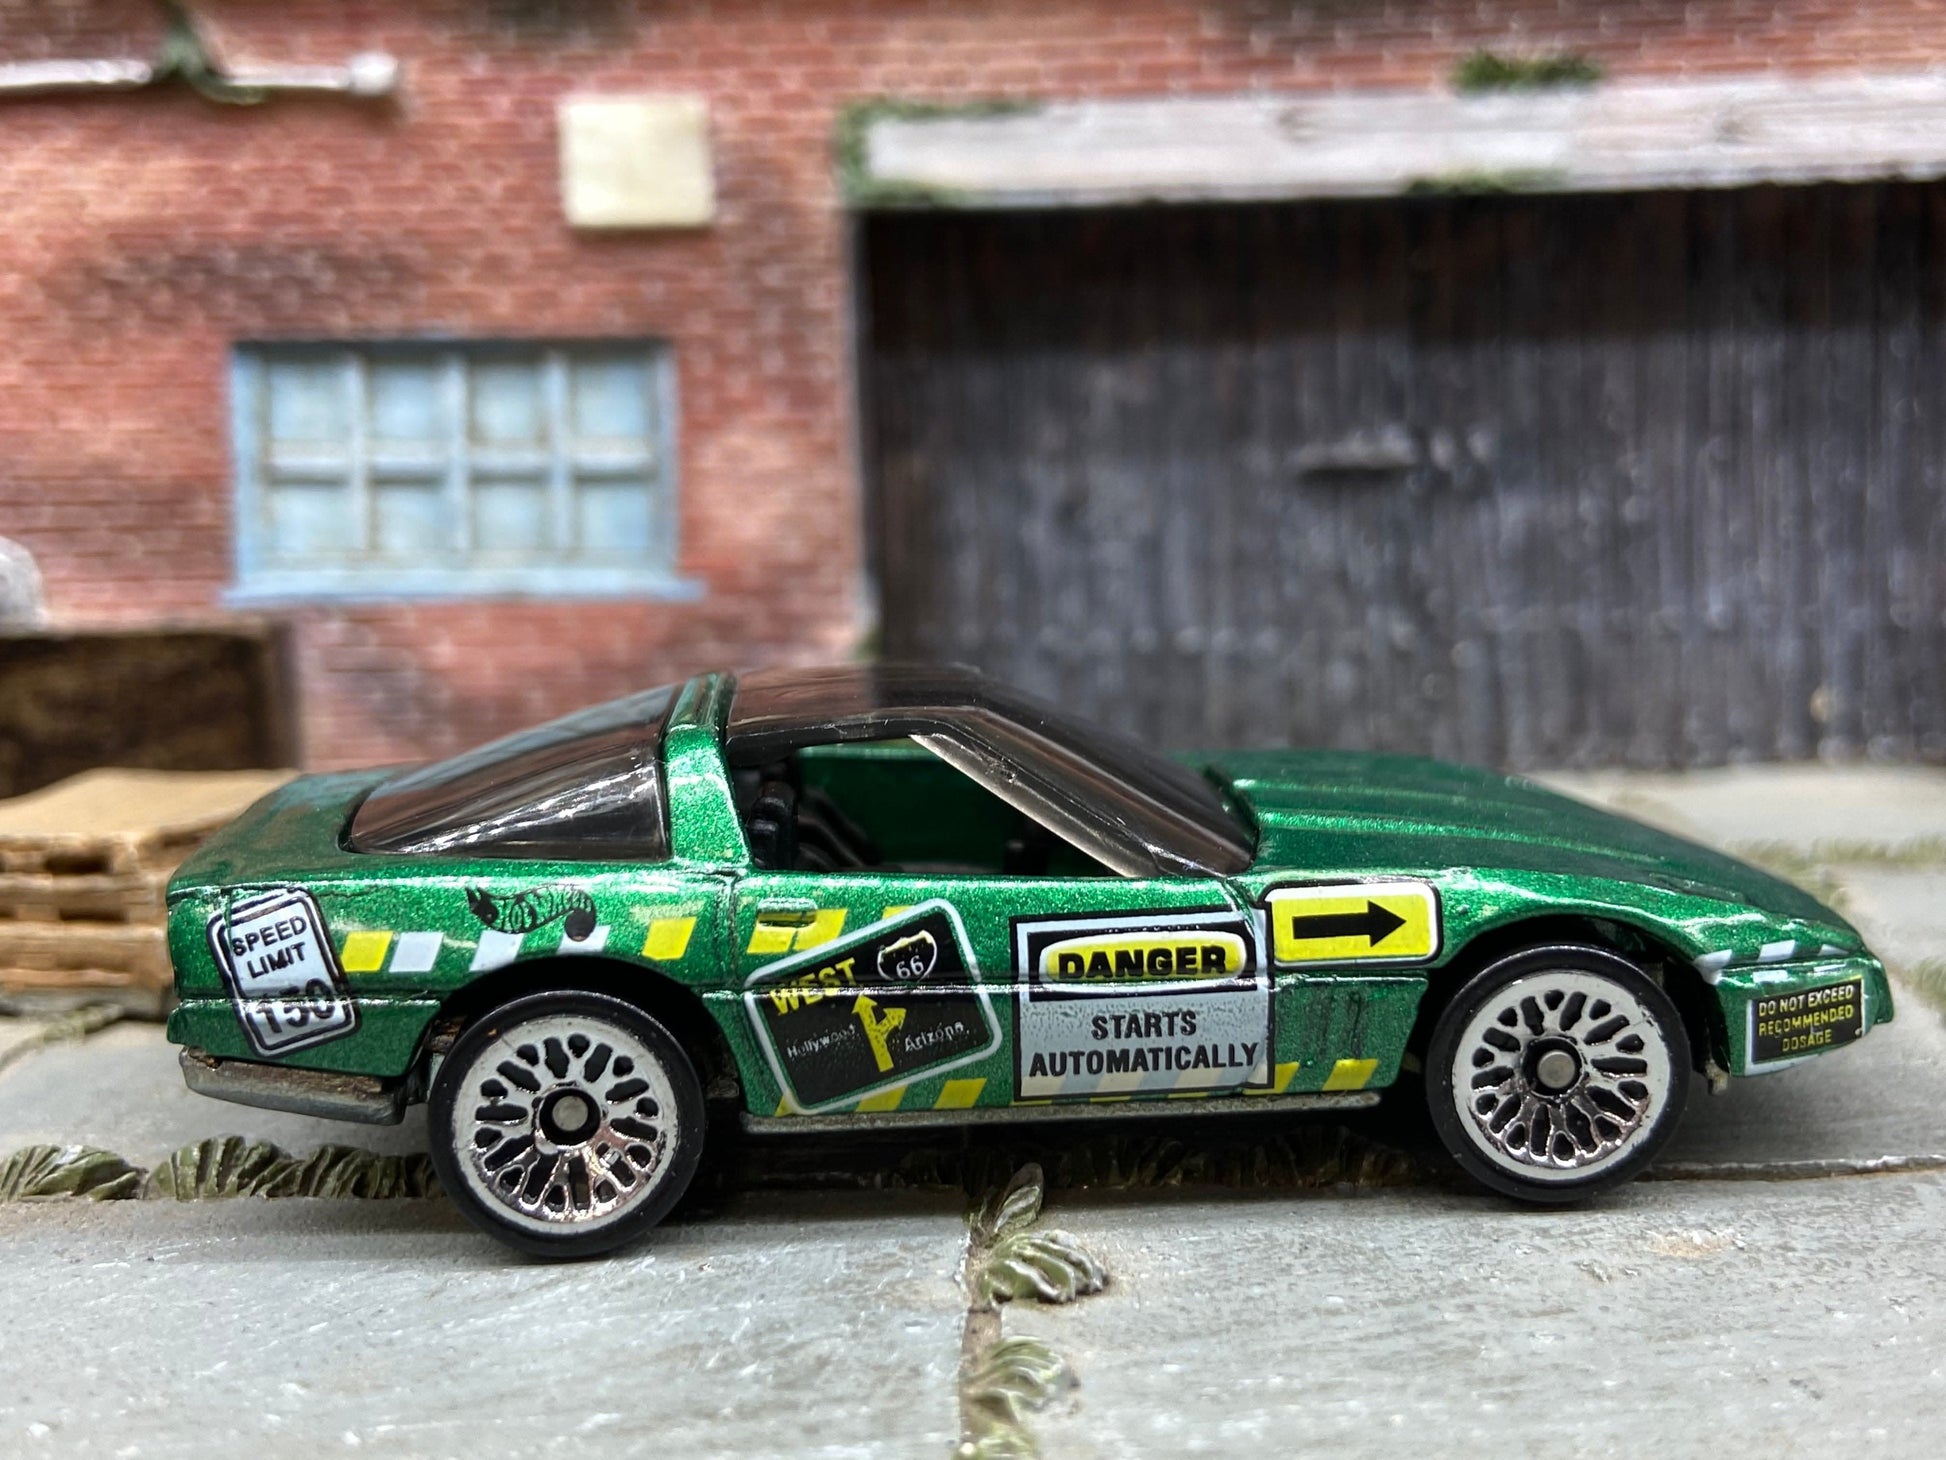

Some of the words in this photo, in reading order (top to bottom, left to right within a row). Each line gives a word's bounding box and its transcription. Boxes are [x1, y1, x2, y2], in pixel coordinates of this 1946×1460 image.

[231, 916, 307, 956] SPEED
[247, 941, 306, 979] LIMIT
[896, 954, 925, 979] 66
[1057, 944, 1228, 980] DANGER
[769, 956, 857, 1016] WEST
[1758, 1000, 1777, 1017] DO
[1779, 994, 1806, 1013] NOT
[1807, 984, 1855, 1008] EXCEED
[255, 978, 335, 1034] 150
[1758, 1004, 1855, 1037] RECOMMENDED
[1091, 1009, 1198, 1041] STARTS
[1781, 1028, 1833, 1052] DOSAGE
[1028, 1042, 1259, 1078] AUTOMATICALLY
